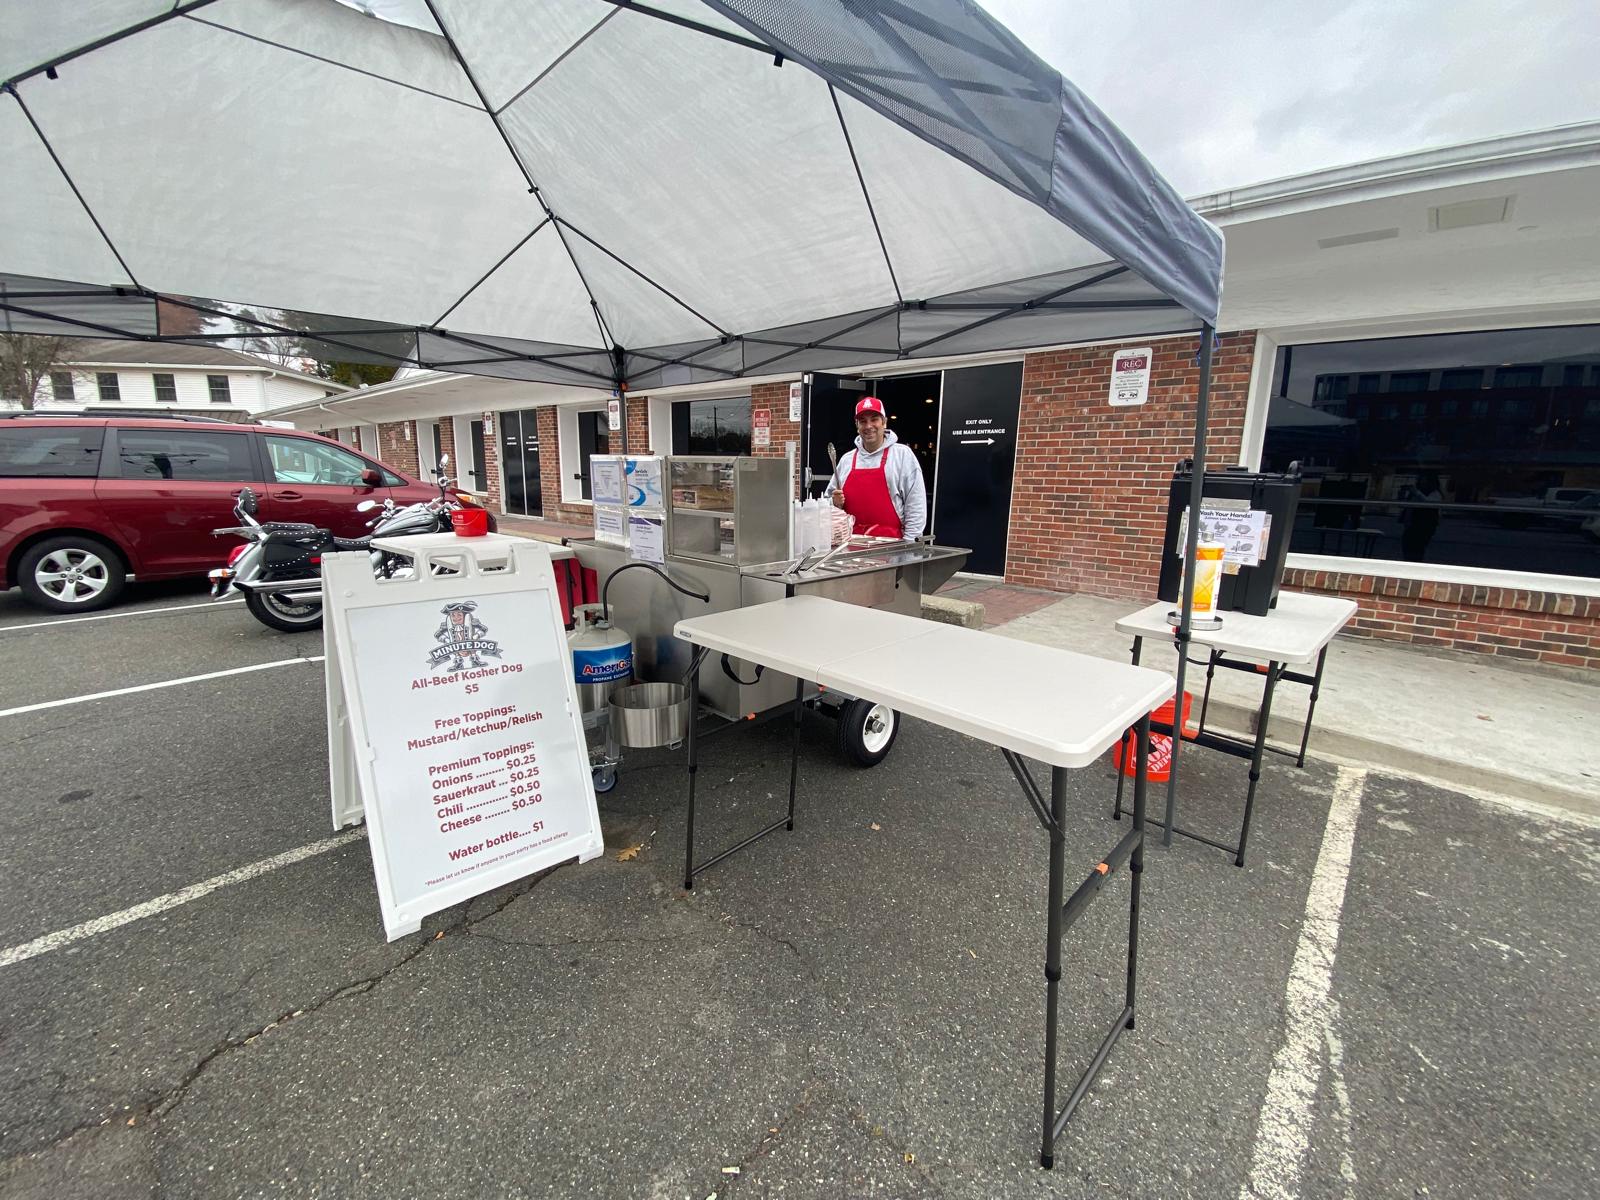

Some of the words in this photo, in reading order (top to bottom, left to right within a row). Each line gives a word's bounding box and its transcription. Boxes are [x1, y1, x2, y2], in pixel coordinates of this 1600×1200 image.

[432, 641, 473, 659] MINUTE
[473, 641, 495, 650] DOG
[412, 673, 461, 690] All-Beef
[461, 666, 499, 680] Kosher
[502, 664, 522, 674] Dog
[465, 684, 480, 694] $5
[408, 712, 542, 750] Mustard/Ketchup/Relish
[435, 717, 460, 729] Free
[463, 705, 516, 722] Toppings:
[429, 755, 481, 776] Premium
[483, 742, 534, 761] Toppings:
[432, 773, 473, 790] Onions
[506, 754, 536, 770] $0.25
[433, 779, 496, 805] Sauerkraut
[510, 767, 539, 783] $0.25
[437, 803, 463, 819] Chili
[510, 780, 540, 797] $0.50
[440, 815, 482, 833] Cheese
[512, 794, 542, 811] $0.50
[449, 843, 483, 861] Water
[533, 821, 544, 833] $1
[461, 866, 475, 874] know
[481, 857, 498, 866] anyone
[505, 851, 516, 859] your
[516, 846, 529, 855] party
[553, 831, 568, 840] allergy
